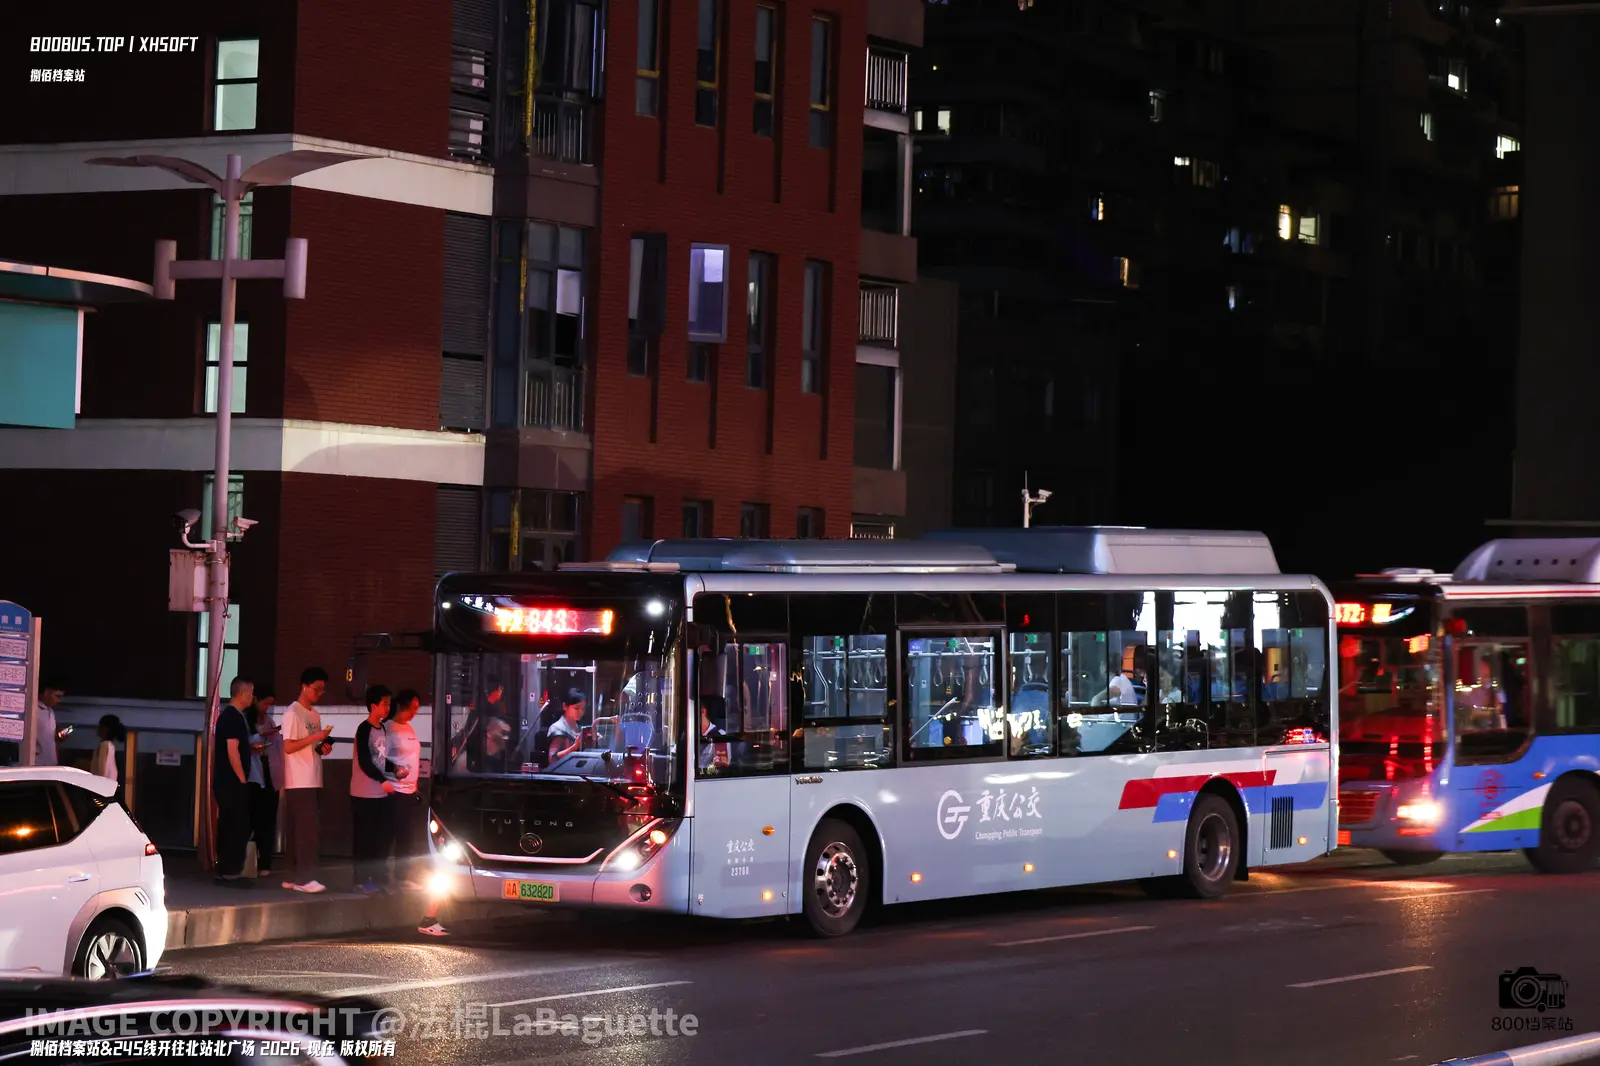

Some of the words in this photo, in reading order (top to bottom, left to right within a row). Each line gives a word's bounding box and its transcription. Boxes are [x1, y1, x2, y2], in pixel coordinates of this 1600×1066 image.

[529, 608, 567, 633] 843
[976, 786, 1043, 823] 重庆公交
[490, 818, 574, 828] YUTONG
[975, 830, 1002, 841] Chongqing
[1003, 829, 1018, 839] Public
[1019, 827, 1043, 838] Transport
[726, 838, 756, 854] 重庆公交
